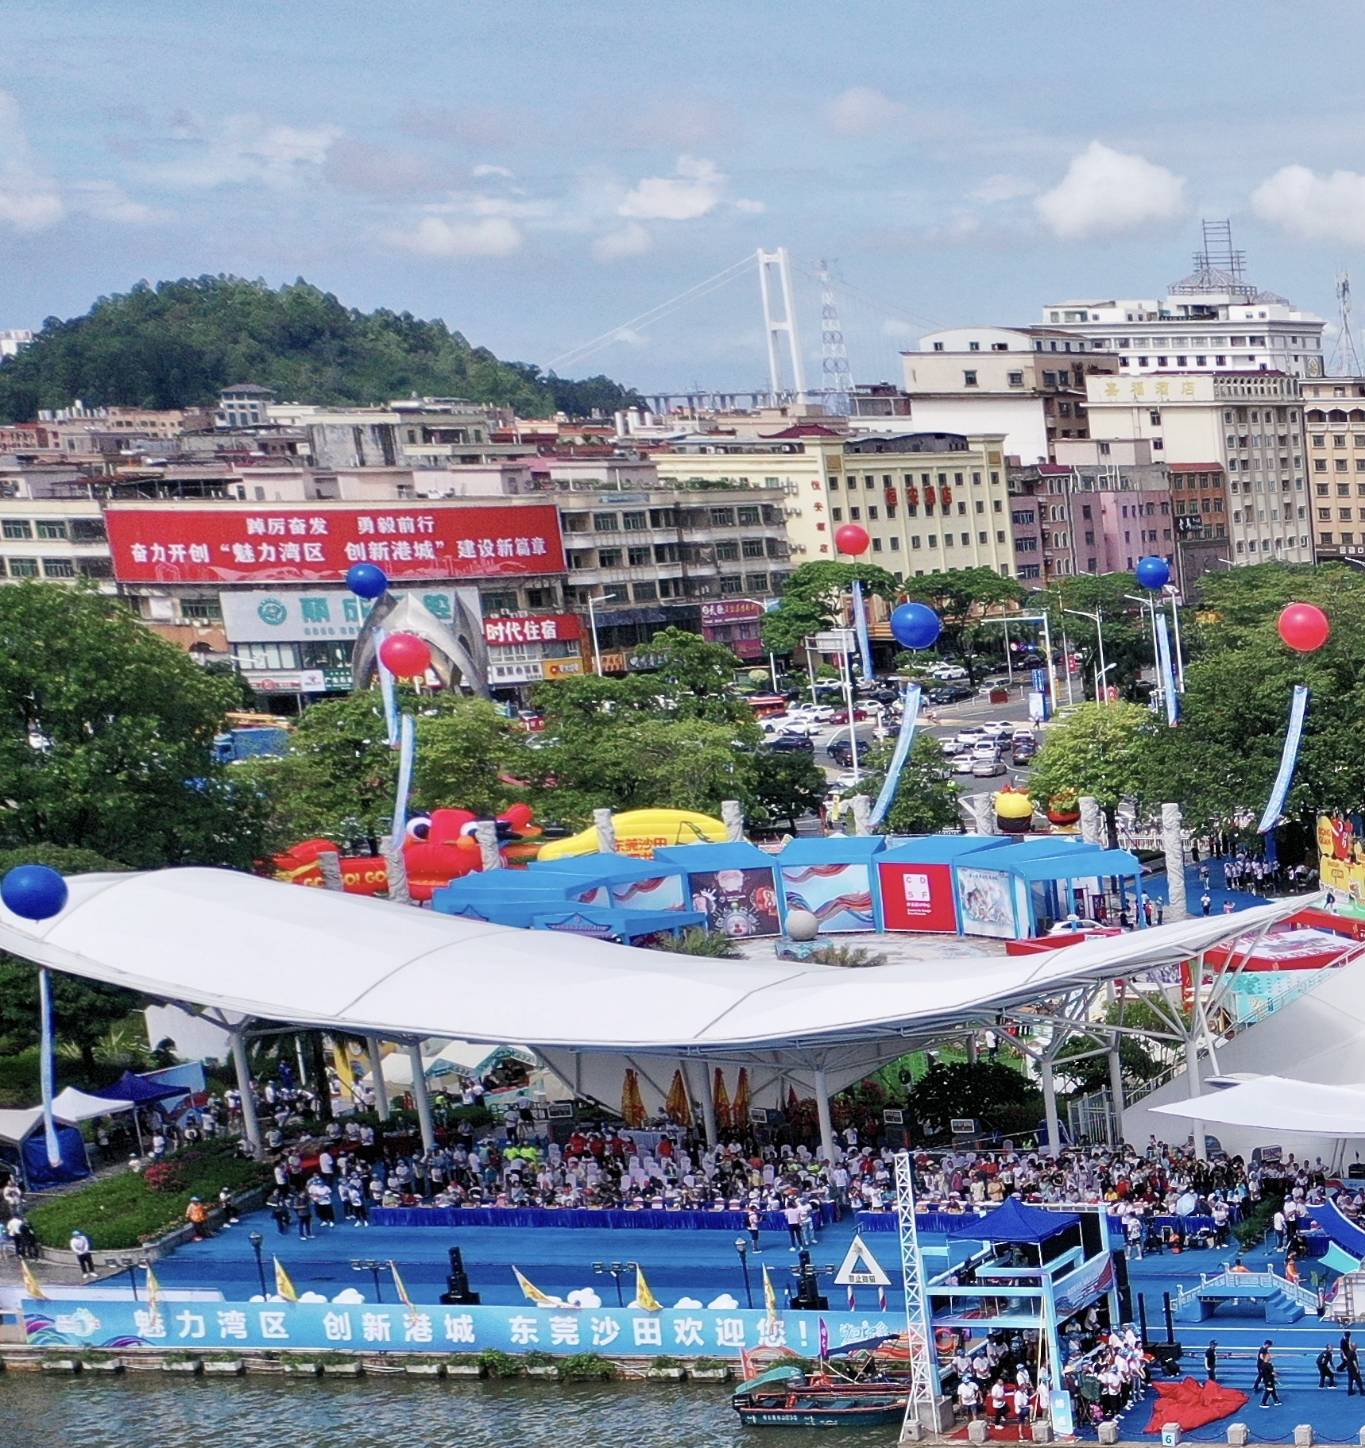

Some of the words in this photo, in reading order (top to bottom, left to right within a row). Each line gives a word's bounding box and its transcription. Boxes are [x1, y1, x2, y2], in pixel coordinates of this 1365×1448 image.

[246, 518, 328, 535] 踔厉奋发
[357, 516, 434, 534] 勇毅前行
[131, 543, 210, 563] 奋力开创
[220, 543, 325, 563] “魅力湾区
[344, 541, 444, 561] 创新港城”
[456, 537, 548, 558] 建设新篇章
[485, 620, 557, 642] 时代住宿
[364, 870, 387, 884] GO
[134, 1310, 289, 1340] 魅力湾区
[323, 1311, 476, 1343] 创新港城
[1165, 1433, 1172, 1444] 6
